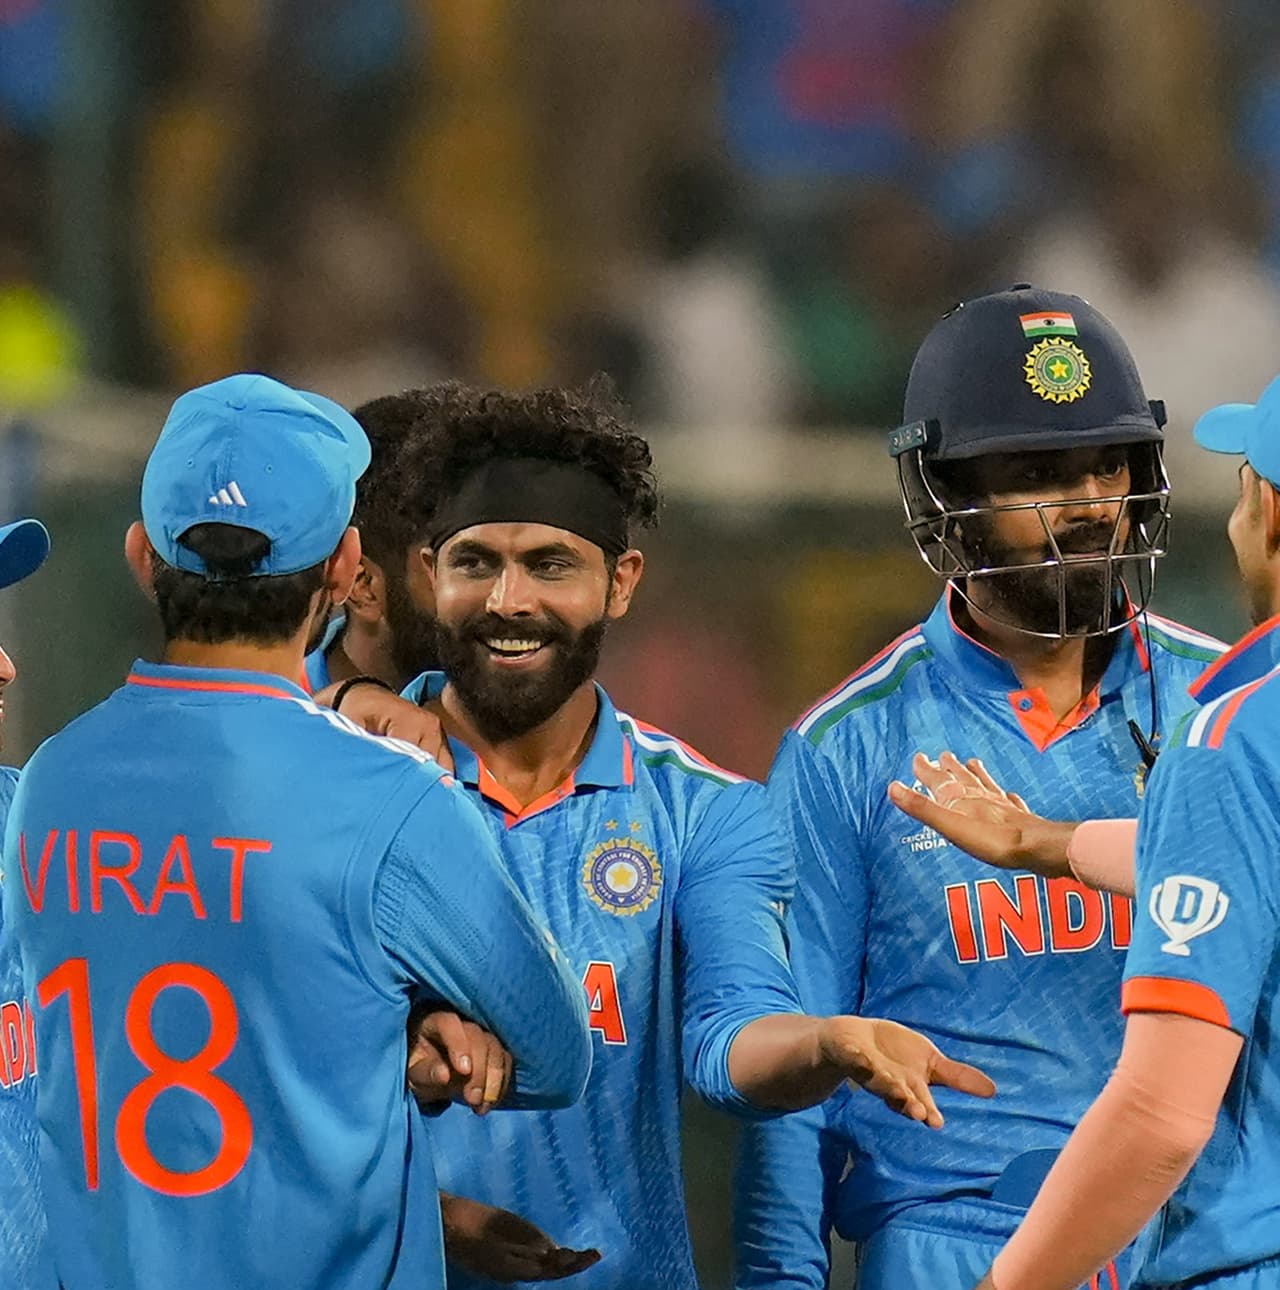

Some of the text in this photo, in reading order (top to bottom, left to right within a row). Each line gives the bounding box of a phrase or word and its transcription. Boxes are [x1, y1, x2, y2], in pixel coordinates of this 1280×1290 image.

[21, 829, 272, 922] VIRAT
[911, 838, 947, 852] INDIA
[37, 957, 253, 1197] 18
